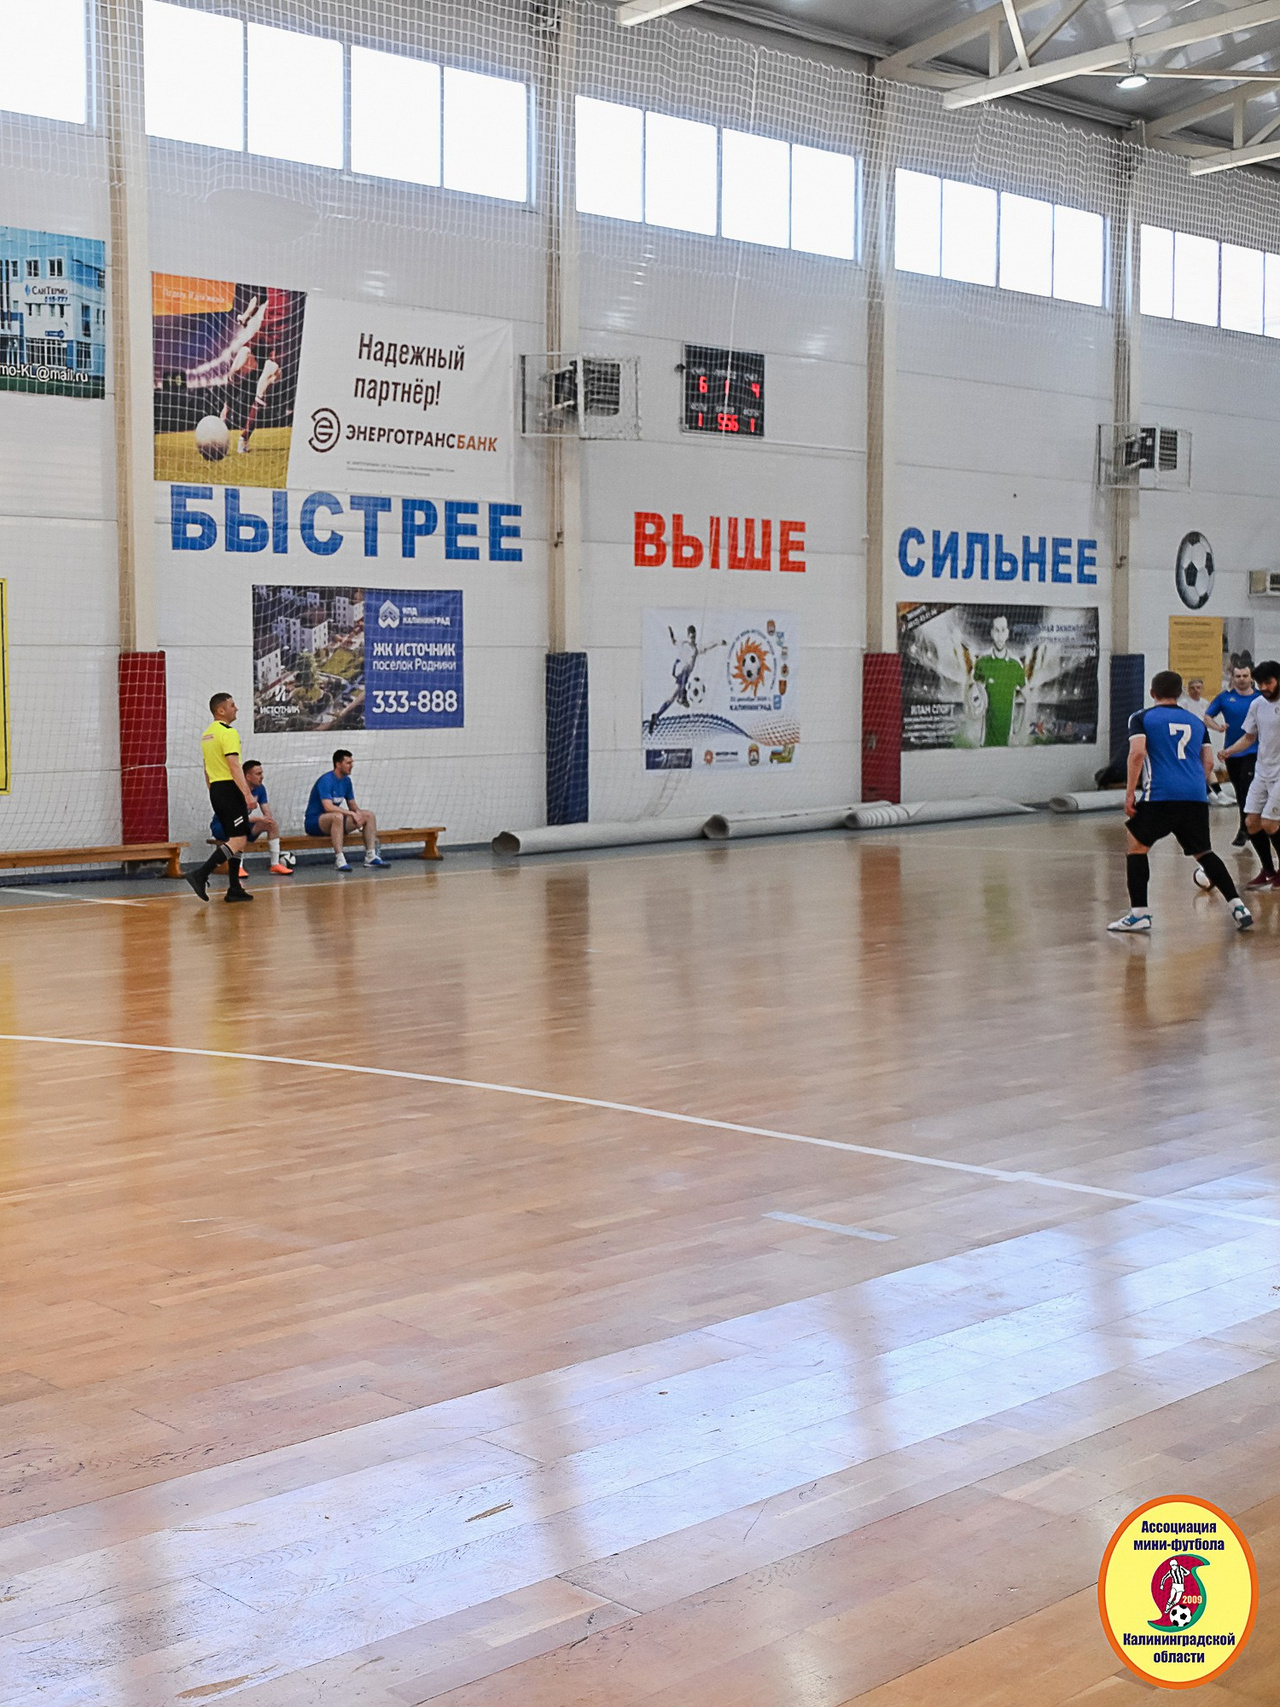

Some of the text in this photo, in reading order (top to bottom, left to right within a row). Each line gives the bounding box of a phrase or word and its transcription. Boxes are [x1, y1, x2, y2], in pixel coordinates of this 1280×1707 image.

[357, 332, 465, 372] Надежный
[353, 375, 441, 412] партнёр!
[699, 375, 708, 393] 6
[751, 382, 760, 399] 4
[346, 423, 498, 453] ЭНЕРГОТРАНСБАНК
[170, 484, 523, 562] БЫСТРЕЕ
[633, 511, 806, 573] ВЫШЕ
[898, 527, 1098, 585] СИЛЬНЕЕ
[372, 642, 456, 657] ЖК ИСТОЧНИК
[372, 657, 457, 672] поселок Родники
[371, 689, 458, 713] 333-888
[1169, 722, 1192, 760] 7
